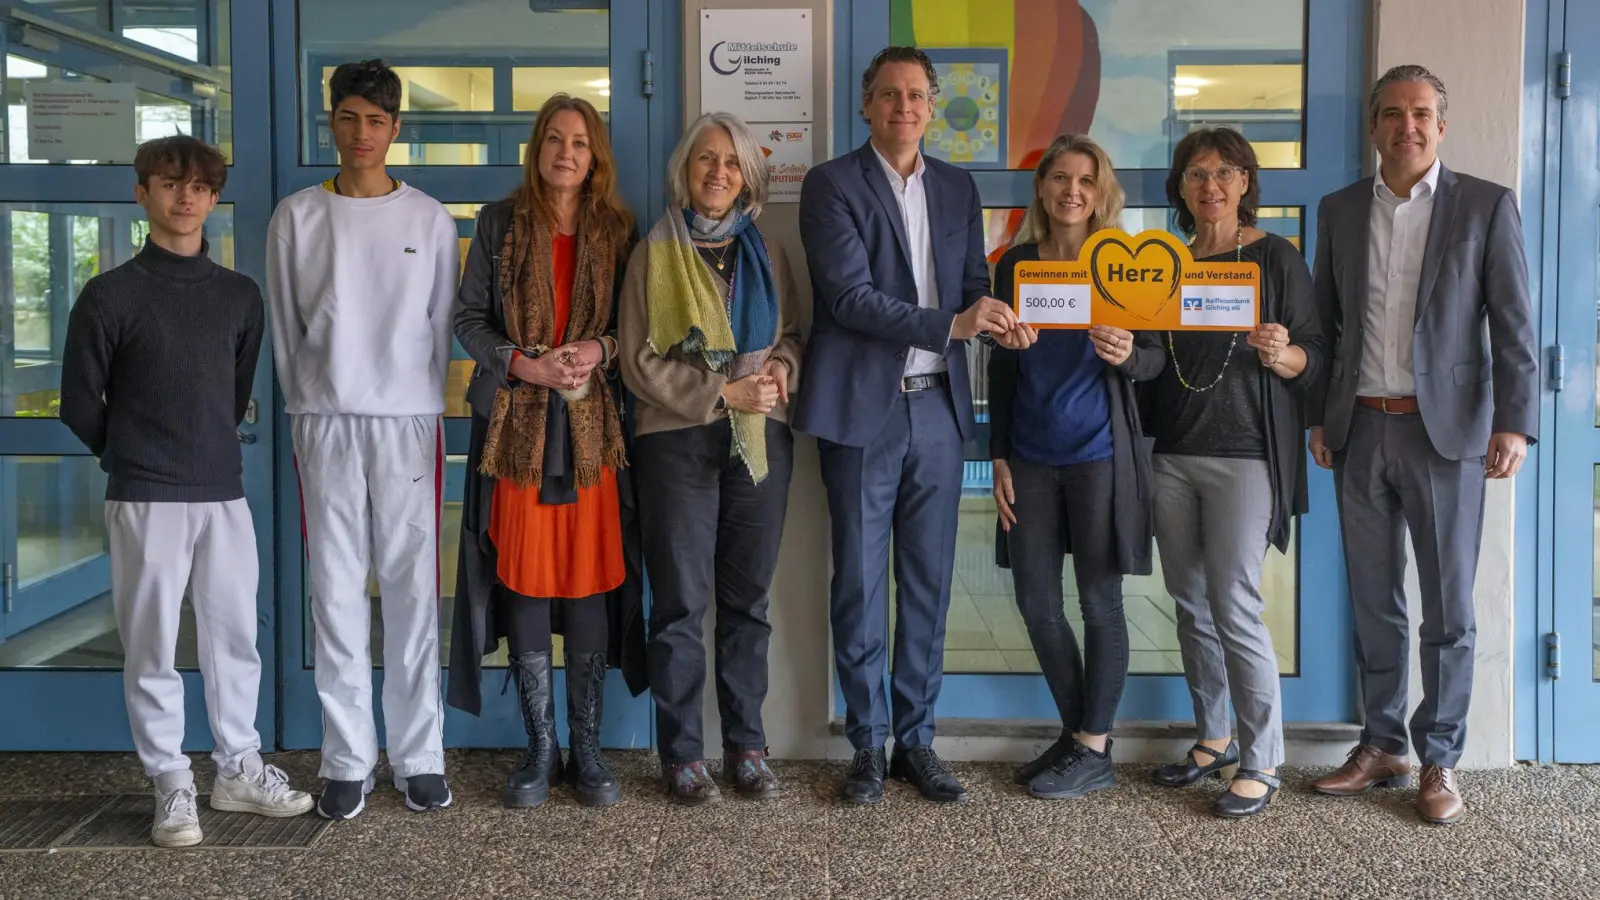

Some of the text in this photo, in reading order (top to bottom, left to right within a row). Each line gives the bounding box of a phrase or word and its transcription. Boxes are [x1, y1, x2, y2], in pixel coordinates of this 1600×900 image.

[727, 42, 798, 52] Mittelschule
[1019, 263, 1256, 283] Gewinnen mit Herz und Verstand.
[1025, 297, 1077, 310] 500,00 €
[1205, 304, 1231, 312] Gilching
